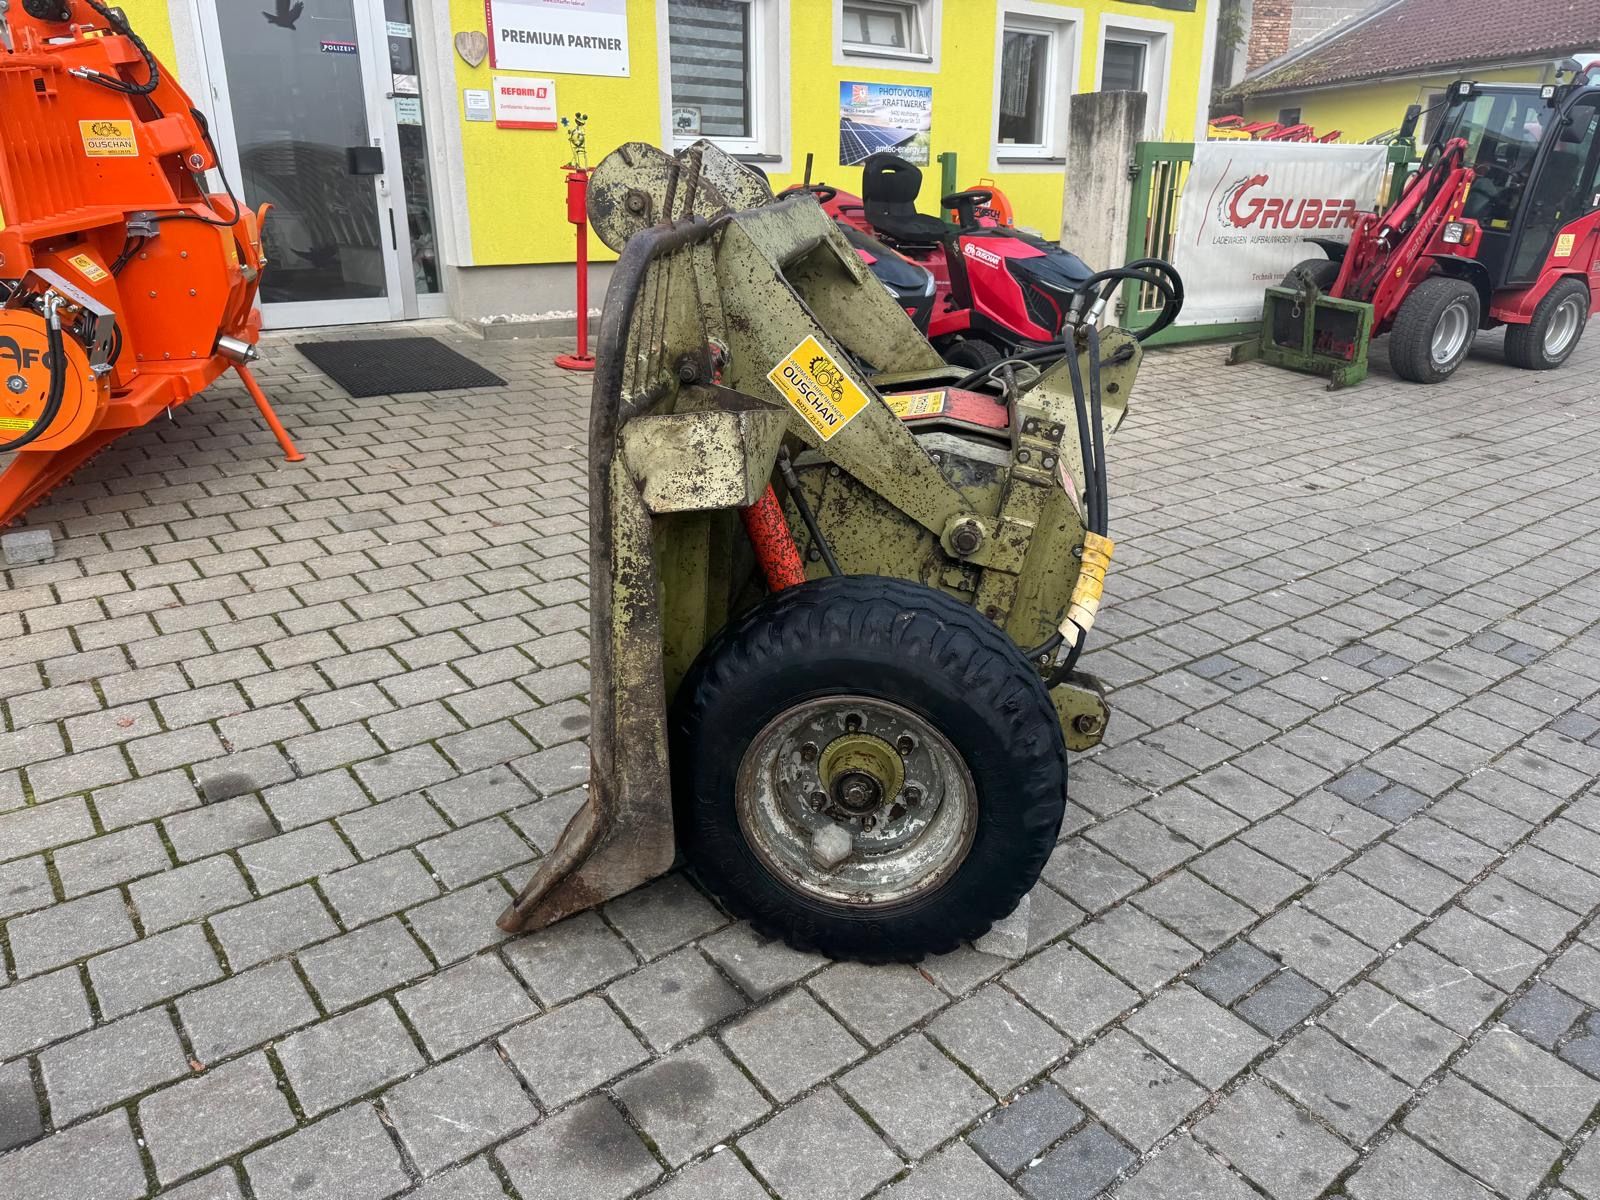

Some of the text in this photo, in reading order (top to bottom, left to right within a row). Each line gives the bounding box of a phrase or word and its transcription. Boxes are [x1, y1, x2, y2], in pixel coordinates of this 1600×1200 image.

[502, 29, 622, 51] PREMIUM PARTNER
[501, 87, 535, 96] REFORM
[879, 87, 930, 98] PHOTOVOLTAIK
[882, 98, 926, 108] KRAFTWERKE
[88, 141, 132, 149] OUSCHAN
[1229, 174, 1356, 230] GRUBER
[1212, 235, 1247, 245] LADEWAGEN
[783, 366, 838, 426] OUSCHAN
